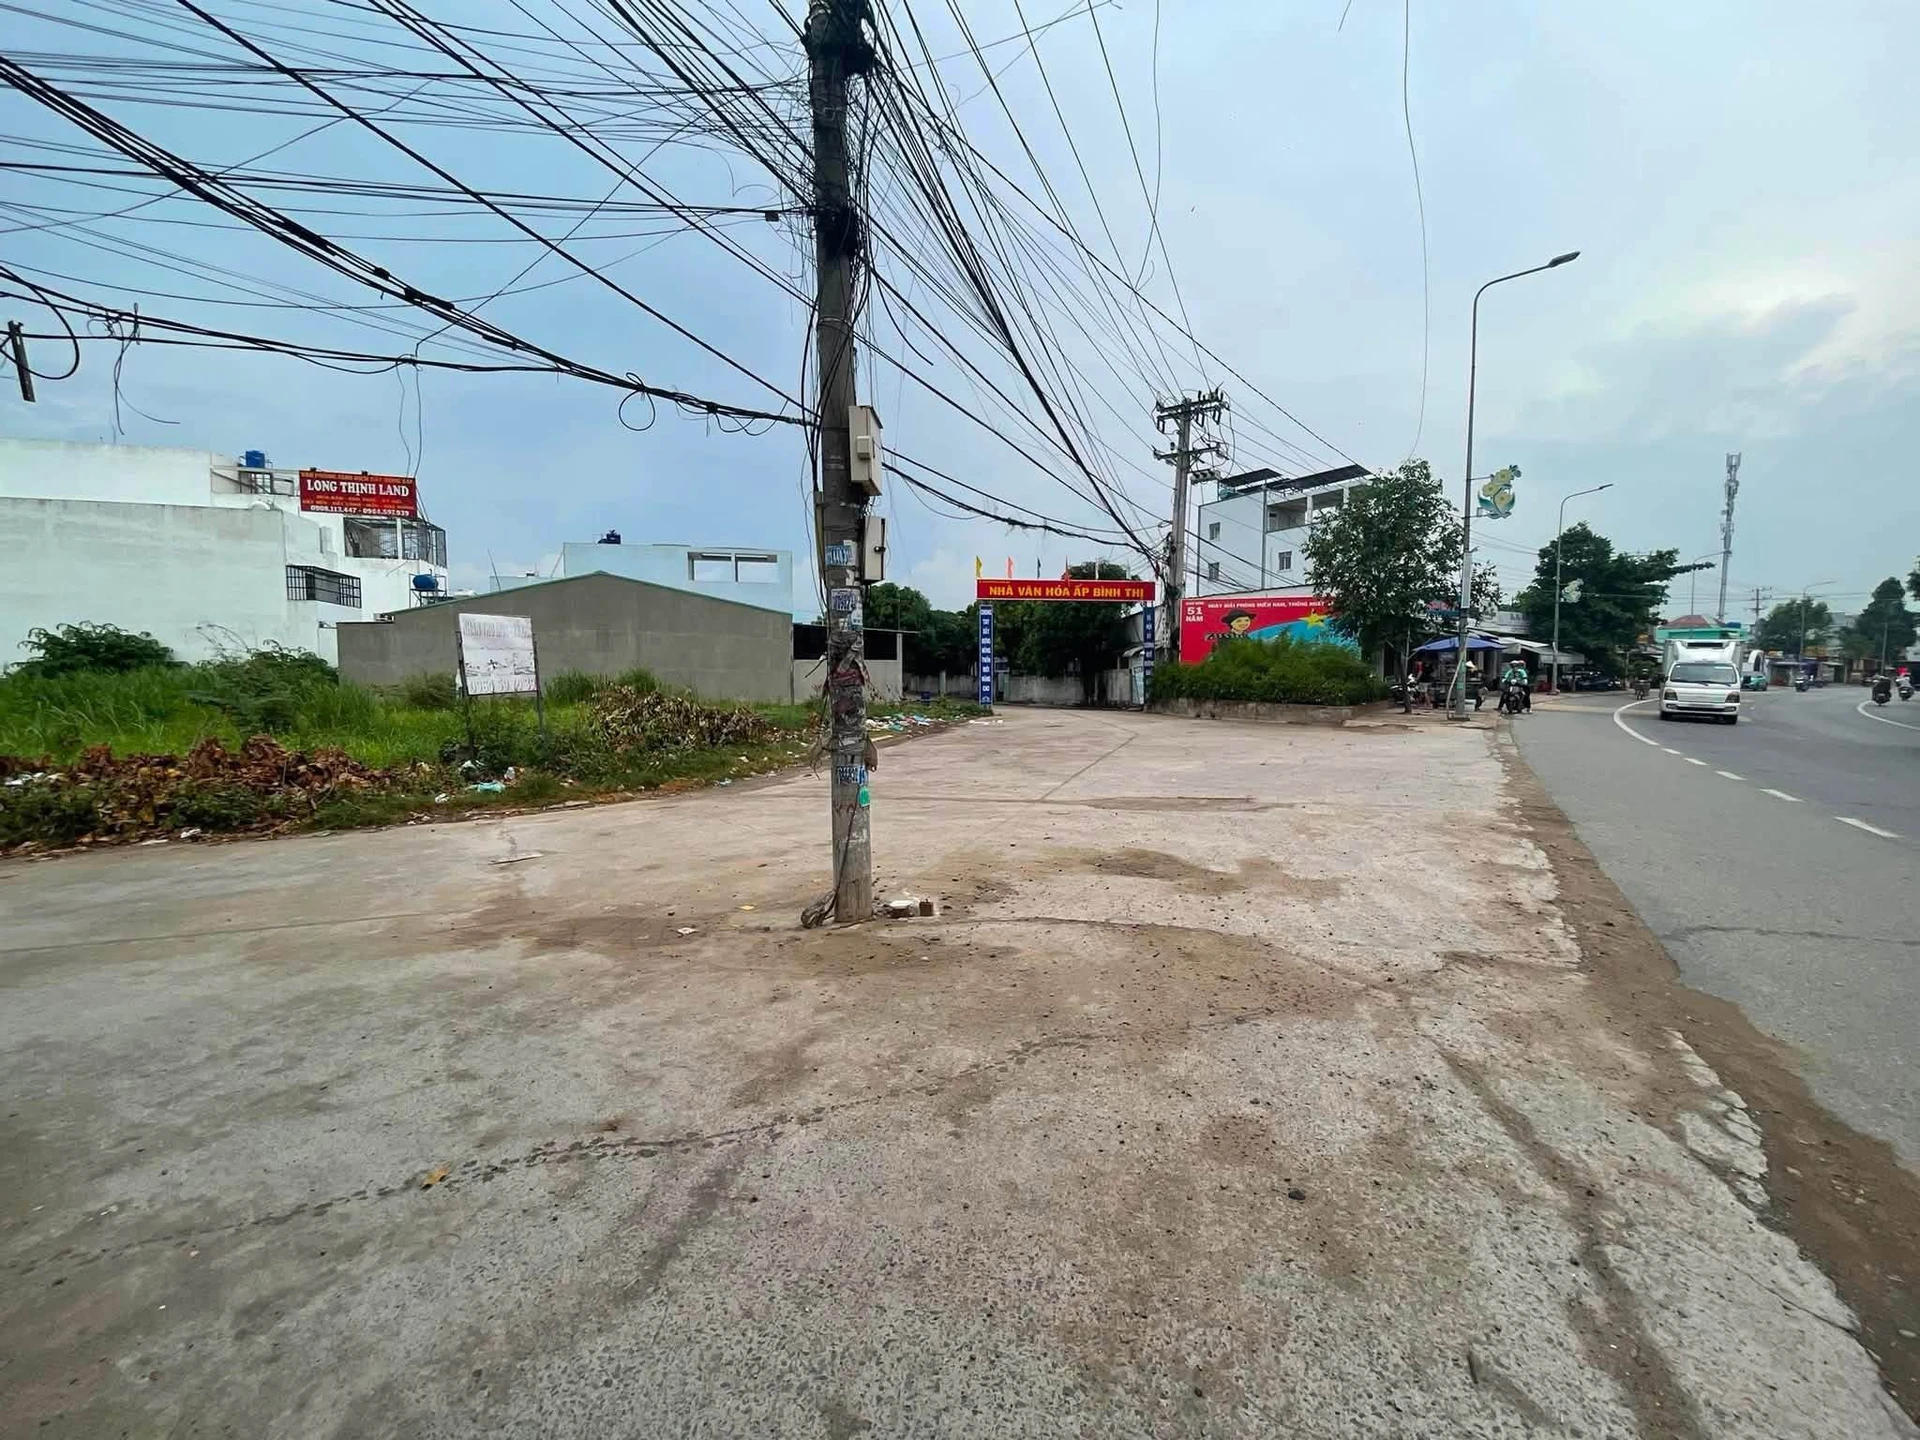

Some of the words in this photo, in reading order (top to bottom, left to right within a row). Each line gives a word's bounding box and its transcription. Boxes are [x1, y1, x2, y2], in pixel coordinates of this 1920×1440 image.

[307, 479, 337, 492] LONG
[340, 482, 376, 496] THỊNH
[379, 484, 409, 497] LAND
[989, 584, 1014, 596] NHÀ
[1046, 584, 1070, 596] HÓA
[1093, 585, 1121, 598] BÌNH
[1187, 606, 1203, 615] 51
